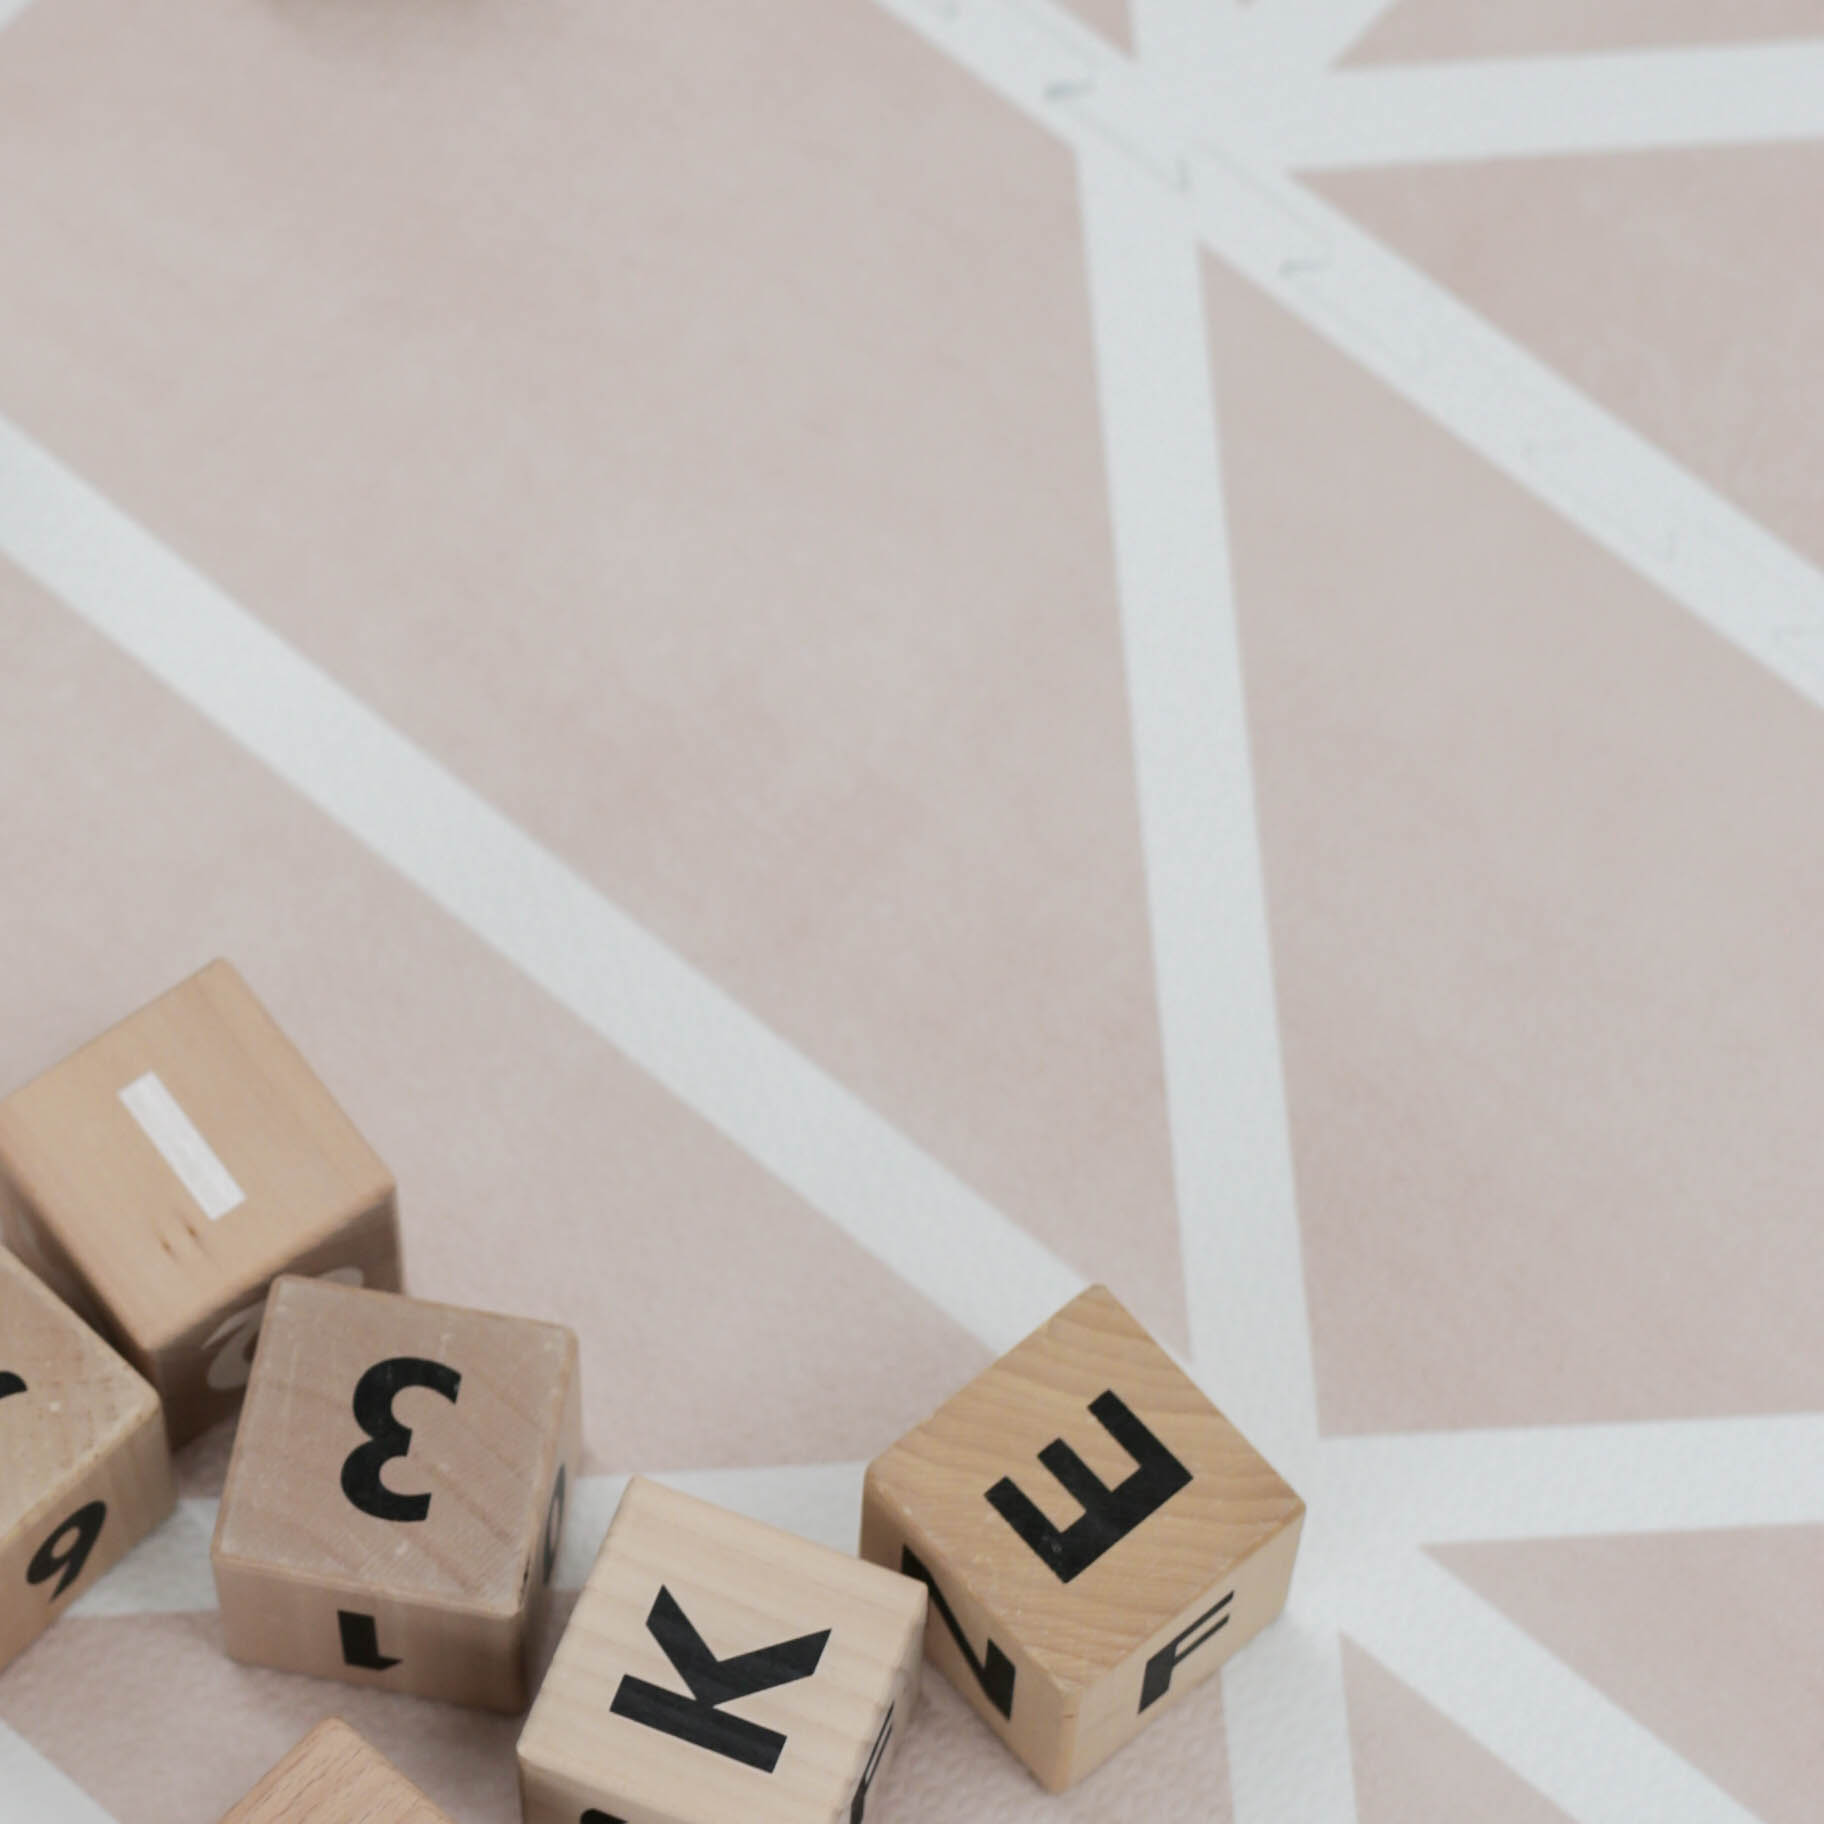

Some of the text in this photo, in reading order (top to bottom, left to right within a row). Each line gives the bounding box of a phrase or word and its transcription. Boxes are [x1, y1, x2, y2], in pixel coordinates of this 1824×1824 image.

[341, 1357, 461, 1522] 3
[984, 1390, 1193, 1583] E
[610, 1585, 831, 1773] K
